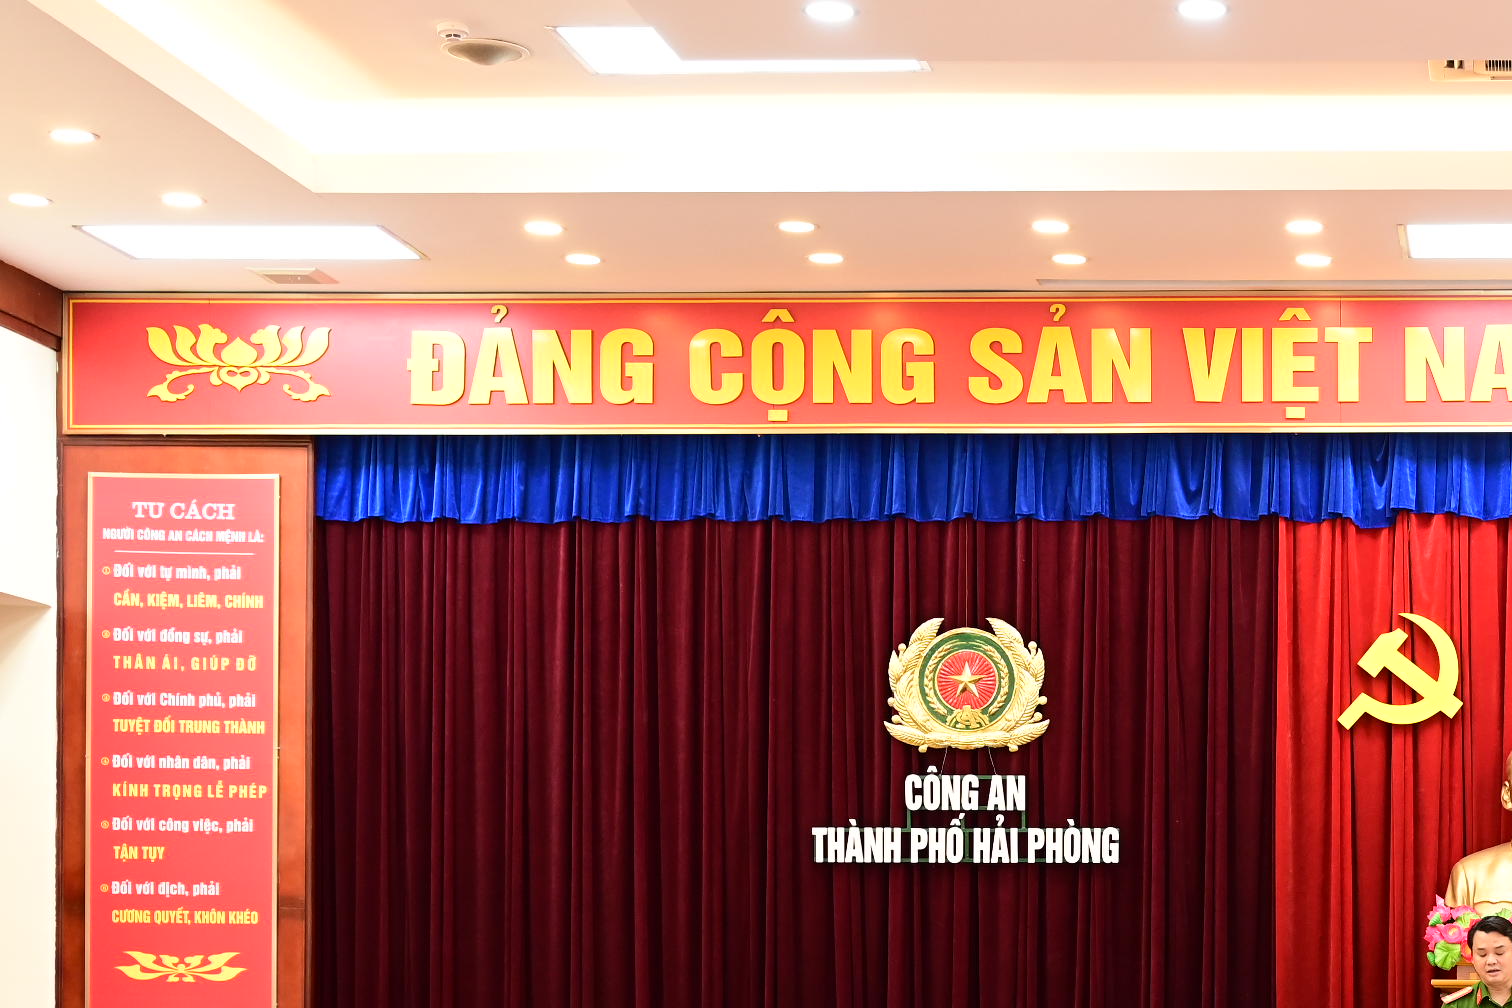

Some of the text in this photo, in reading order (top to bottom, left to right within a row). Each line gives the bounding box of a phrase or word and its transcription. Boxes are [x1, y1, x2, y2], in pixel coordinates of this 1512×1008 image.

[406, 303, 655, 406] ĐẢNG
[688, 308, 936, 422] CỘNG
[967, 303, 1153, 406] SẢN
[1184, 307, 1374, 419] VIỆT
[170, 500, 235, 520] CÁCH
[137, 528, 165, 540] CÔNG
[168, 530, 182, 541] AN
[186, 529, 213, 541] CÁCH
[113, 562, 241, 581] Đối với tự mình, phải
[148, 592, 183, 609] KIỆM,
[187, 592, 221, 608] LIÊM,
[225, 592, 263, 608] CHÍNH
[113, 626, 133, 641] Đối
[137, 628, 156, 642] với
[194, 631, 212, 645] sự,
[216, 628, 242, 644] phải
[113, 654, 256, 671] THÂN ÁI, GIÚP ĐỠ
[113, 716, 265, 734] TUYỆT ĐỐI TRUNG THÀNH
[113, 781, 148, 796] KÍNH
[154, 784, 202, 800] TRỌNG
[229, 783, 267, 798] PHÉP
[905, 766, 1025, 810] CÔNG AN
[812, 813, 1119, 863] THÀNH PHỐ HẢI PHÒNG
[114, 844, 164, 862] TẬN TỤY
[112, 907, 258, 924] CƯƠNG QUYẾT, KHÔN KHÉO
